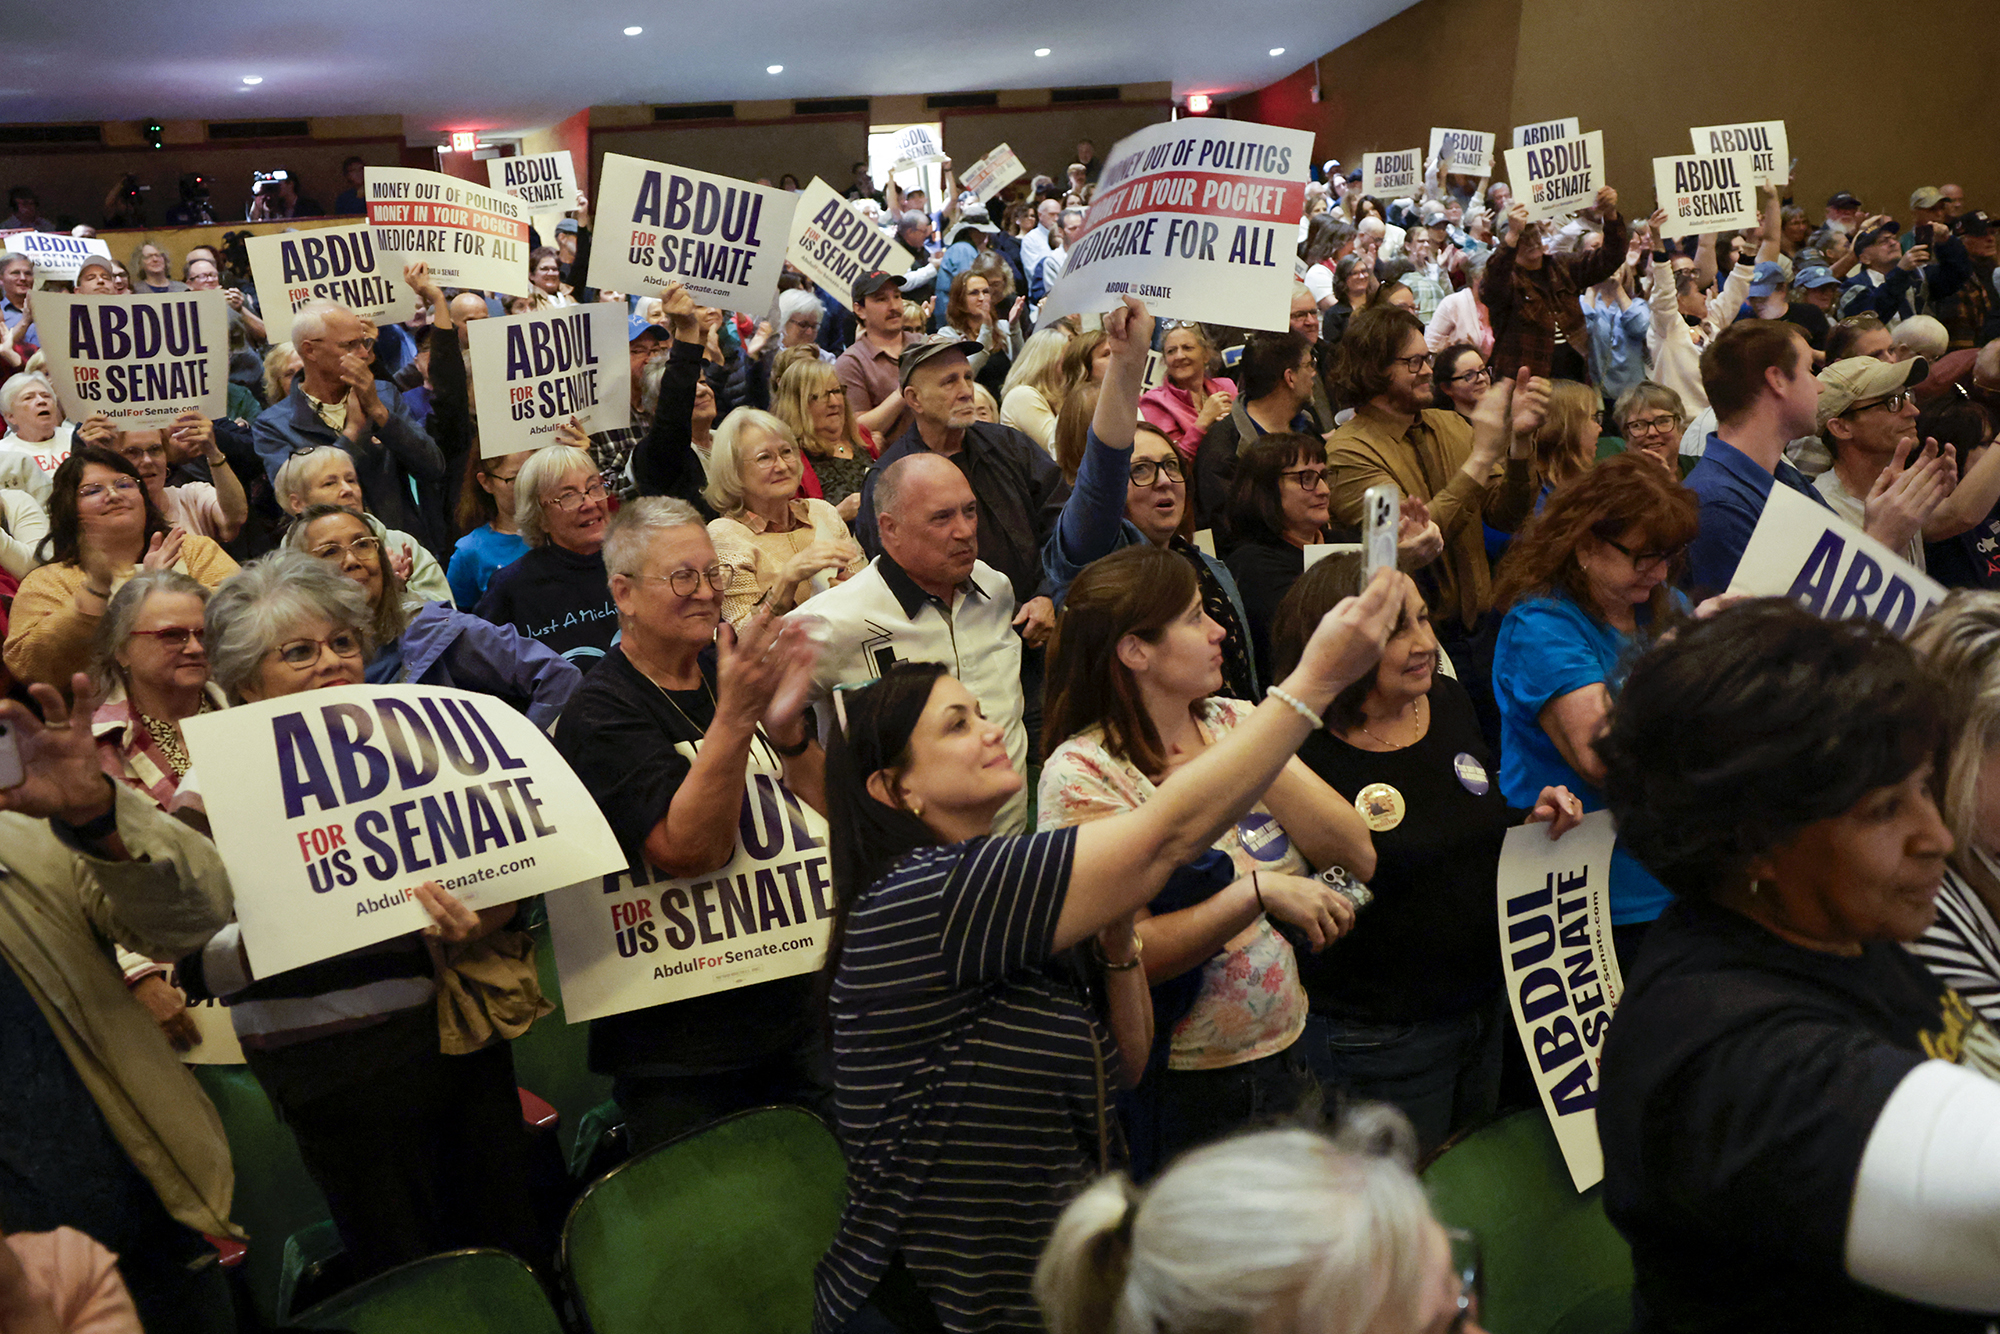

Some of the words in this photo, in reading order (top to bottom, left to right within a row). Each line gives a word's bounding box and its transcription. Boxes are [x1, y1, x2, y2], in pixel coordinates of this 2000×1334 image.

[1142, 141, 1174, 173] OUT
[1172, 139, 1198, 166] OF
[1198, 139, 1292, 175] POLITICS
[1709, 126, 1773, 154] ABDUL
[504, 157, 562, 187] ABDUL
[1374, 153, 1415, 175] ABDUL
[1526, 139, 1592, 182] ABDUL
[1675, 157, 1741, 194] ABDUL
[519, 182, 564, 203] SENATE
[1126, 181, 1149, 212] IN
[1148, 177, 1198, 207] YOUR
[1201, 179, 1287, 216] POCKET
[1383, 173, 1415, 188] SENATE
[1545, 171, 1592, 202] SENATE
[372, 182, 411, 199] MONEY
[415, 183, 441, 200] OUT
[445, 187, 462, 202] OF
[465, 191, 518, 218] POLITICS
[631, 169, 764, 248] ABDUL
[1679, 204, 1692, 218] US
[1692, 190, 1745, 217] SENATE
[373, 205, 410, 222] MONEY
[414, 205, 428, 223] IN
[433, 206, 469, 226] YOUR
[472, 213, 519, 237] POCKET
[630, 230, 657, 247] FOR
[812, 198, 892, 271] ABDUL
[24, 235, 94, 255] ABDUL
[280, 230, 376, 285] ABDU
[376, 228, 447, 252] MEDICARE
[453, 231, 486, 257] FOR
[491, 238, 519, 263] ALL
[628, 246, 655, 267] US
[658, 234, 757, 287] SENATE
[798, 235, 816, 252] US
[813, 238, 862, 286] SENA
[1061, 217, 1159, 280] MEDICARE
[1164, 218, 1220, 262] FOR
[1228, 225, 1277, 268] ALL
[441, 268, 460, 277] SENATE
[642, 275, 731, 297] AbdulrSenate.com
[1105, 281, 1130, 294] ABDUL
[1138, 283, 1173, 299] SENATE
[288, 287, 310, 303] FOR
[69, 301, 208, 360] ABDUL
[506, 312, 599, 382] ABDUL
[73, 366, 100, 382] FOR
[76, 380, 101, 401] US
[105, 358, 210, 404] SENATE
[509, 385, 534, 405] FOR
[511, 399, 535, 422] US
[537, 369, 600, 419] SENATE
[1786, 527, 1938, 639] ABD
[526, 619, 560, 640] Just
[562, 612, 578, 628] A
[271, 697, 528, 820] ABDUL
[297, 823, 347, 864] FOR
[354, 776, 558, 882] SENATE
[306, 848, 358, 895] US
[356, 854, 536, 918] AbdulFSenate.com
[610, 898, 653, 931] FOR
[659, 856, 837, 951] SENATE
[615, 920, 660, 959] US
[1557, 864, 1613, 1049] SENATE
[653, 936, 814, 980] AbdulForSenate.com
[1506, 871, 1598, 1118] ABDUL
